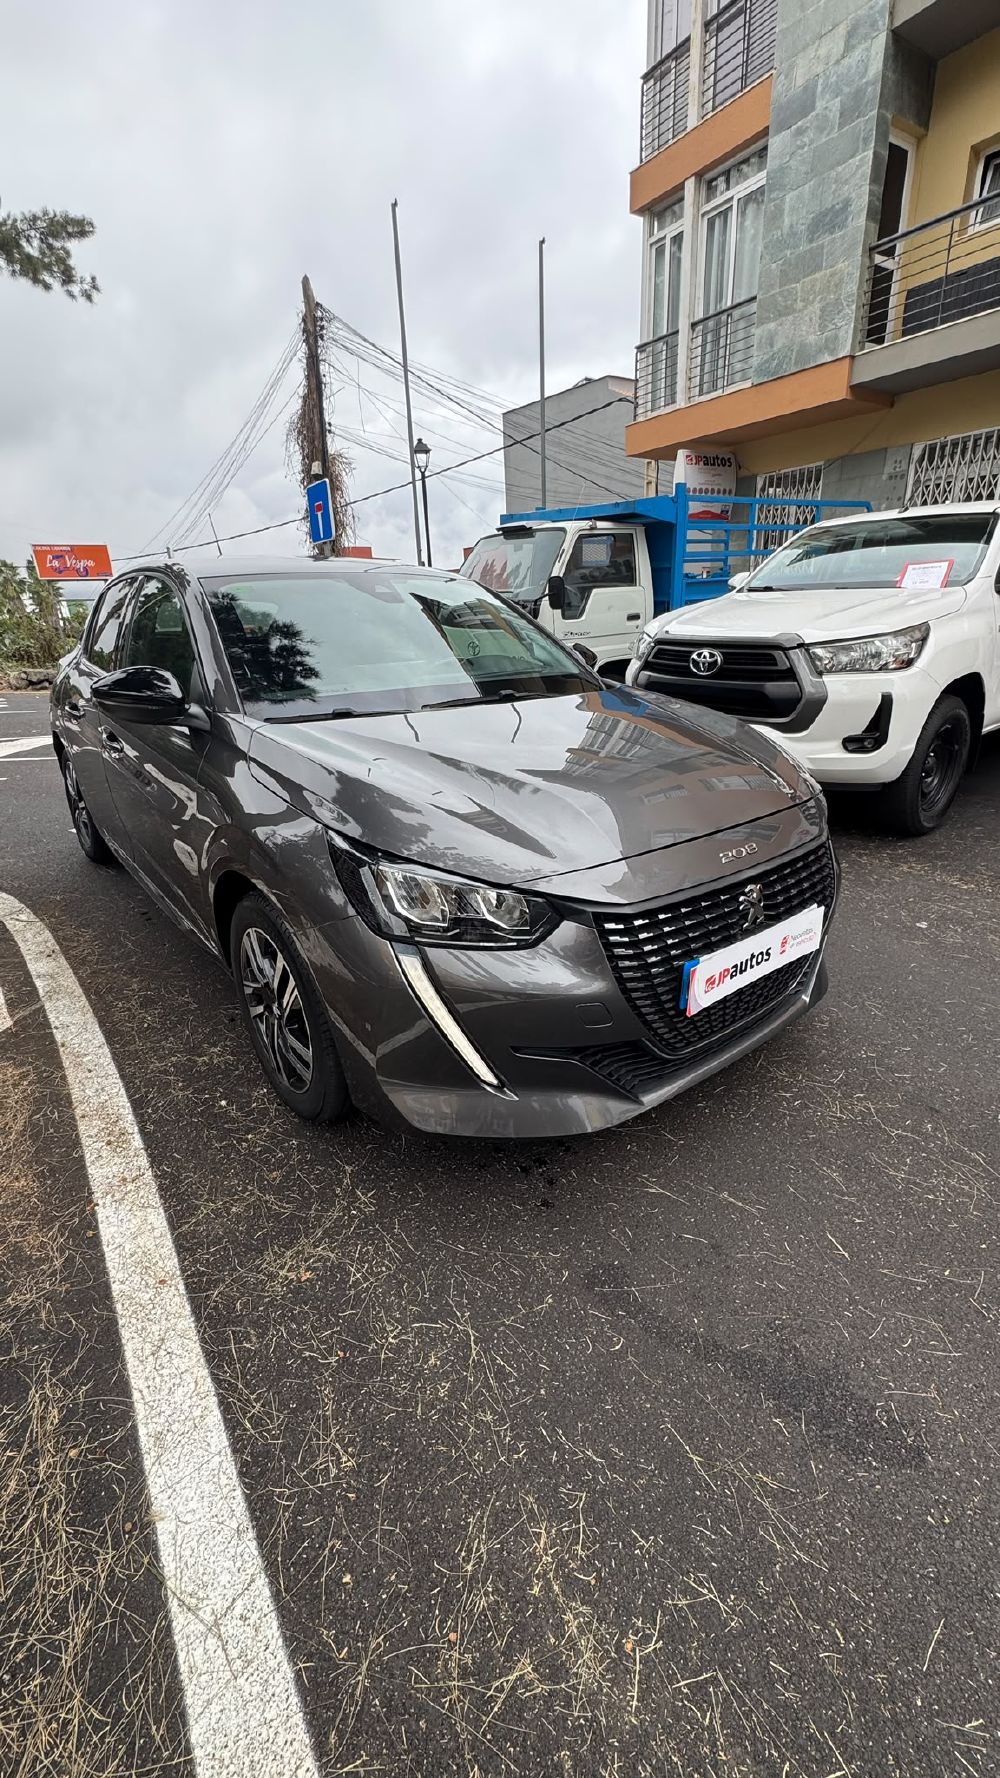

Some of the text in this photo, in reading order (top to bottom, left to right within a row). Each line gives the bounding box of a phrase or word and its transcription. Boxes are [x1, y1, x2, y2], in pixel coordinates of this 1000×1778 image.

[694, 454, 733, 468] JPautos
[46, 554, 96, 572] La Vespa
[719, 842, 758, 864] 208
[716, 946, 772, 988] JPautos
